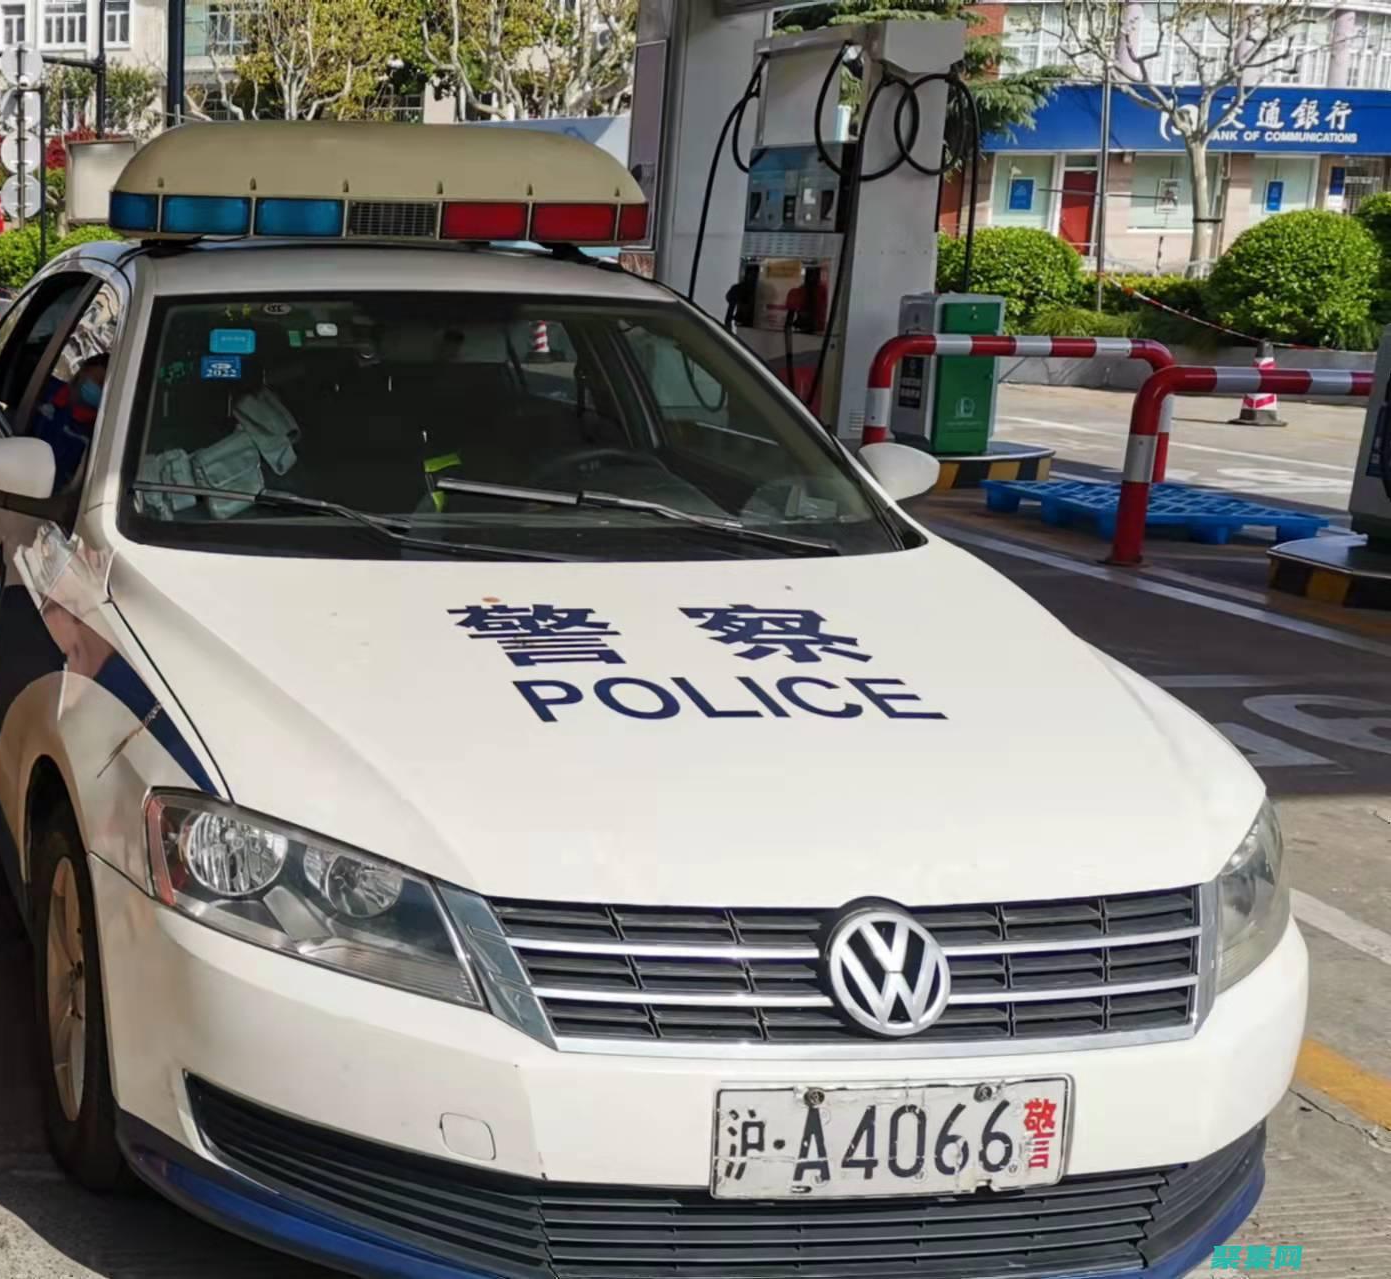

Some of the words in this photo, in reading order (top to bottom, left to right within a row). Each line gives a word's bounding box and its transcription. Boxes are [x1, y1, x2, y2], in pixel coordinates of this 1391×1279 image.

[1208, 130, 1238, 142] ANK
[1243, 130, 1260, 142] OF
[1264, 130, 1359, 144] COMMUNICATIONS
[206, 368, 238, 378] 2022
[447, 603, 873, 667] 警察
[511, 675, 949, 723] POLICE
